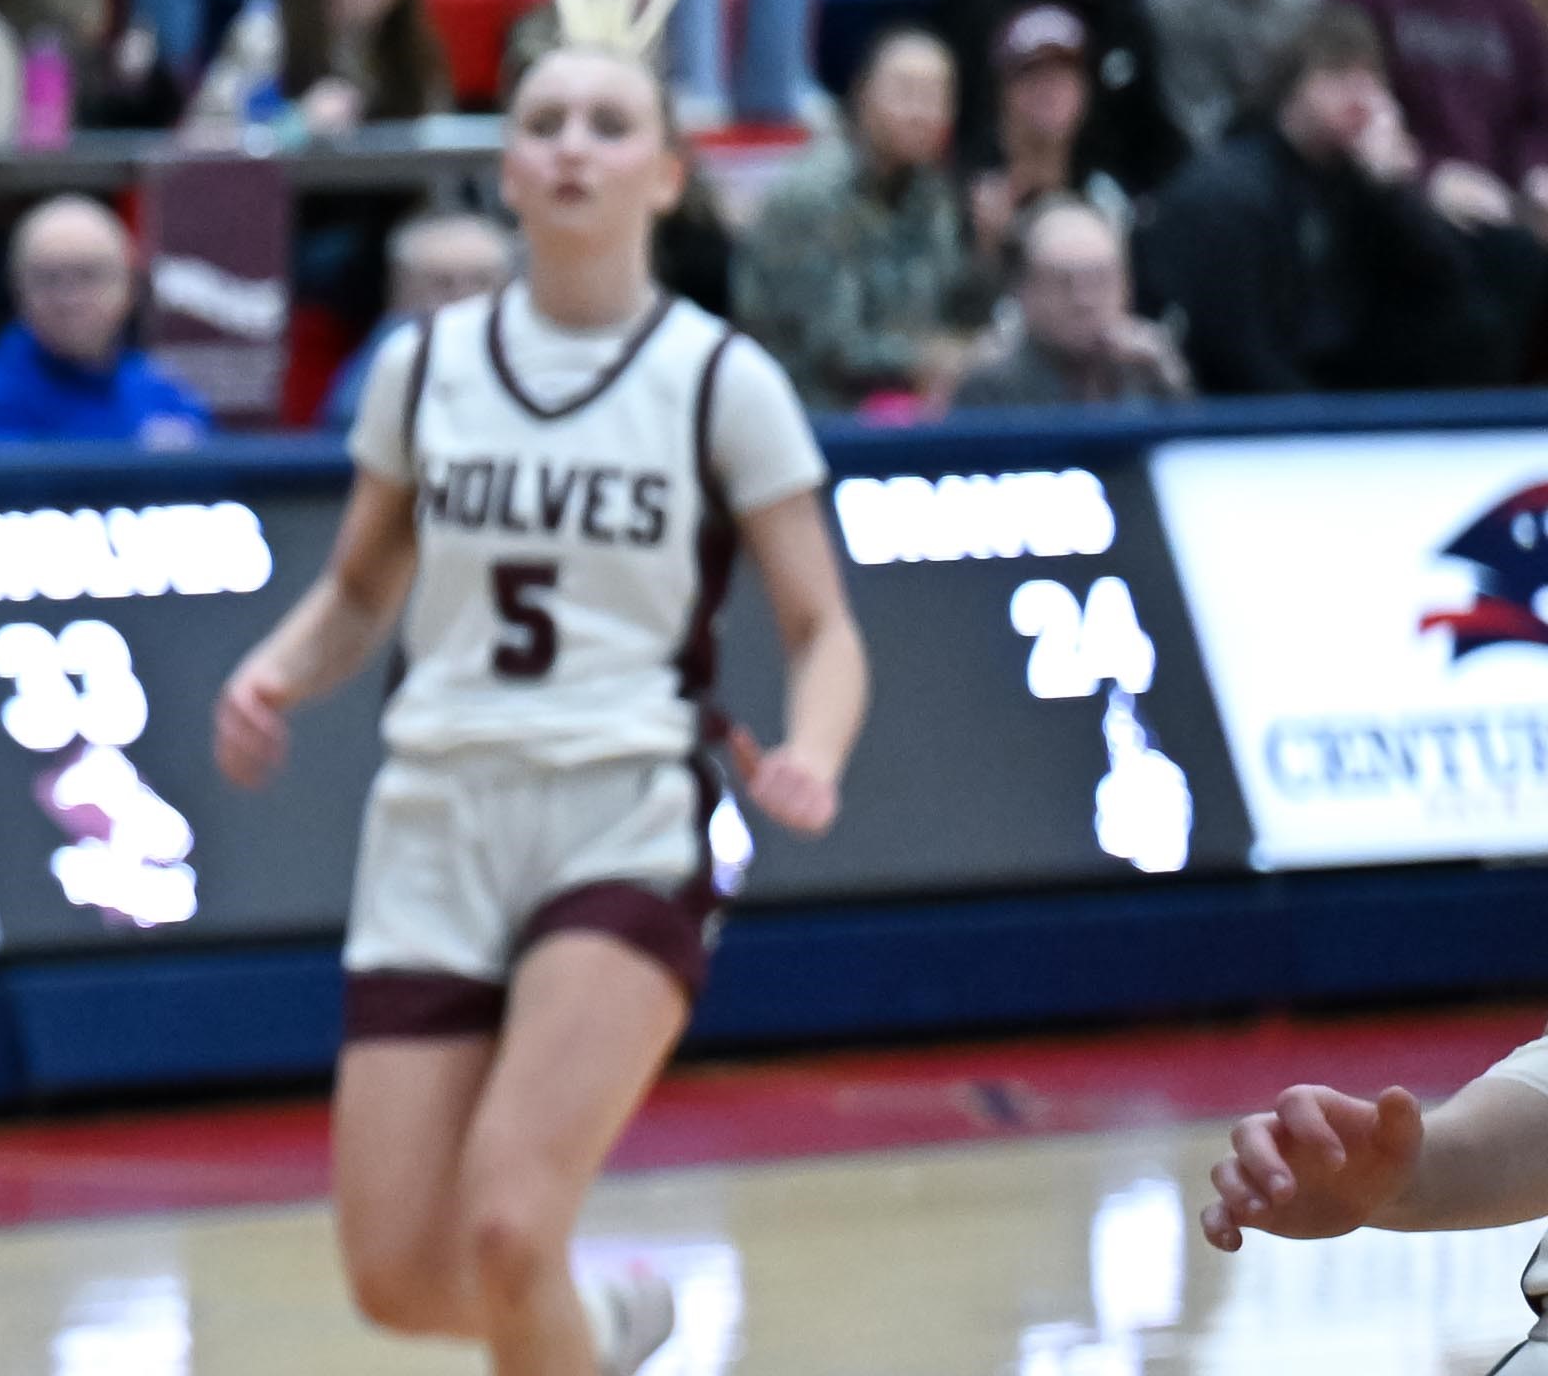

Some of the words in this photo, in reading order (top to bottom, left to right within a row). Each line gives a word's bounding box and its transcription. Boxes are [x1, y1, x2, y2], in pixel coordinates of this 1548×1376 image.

[416, 456, 669, 547] WOLVES
[488, 556, 561, 684] 5
[1010, 576, 1155, 699] 24
